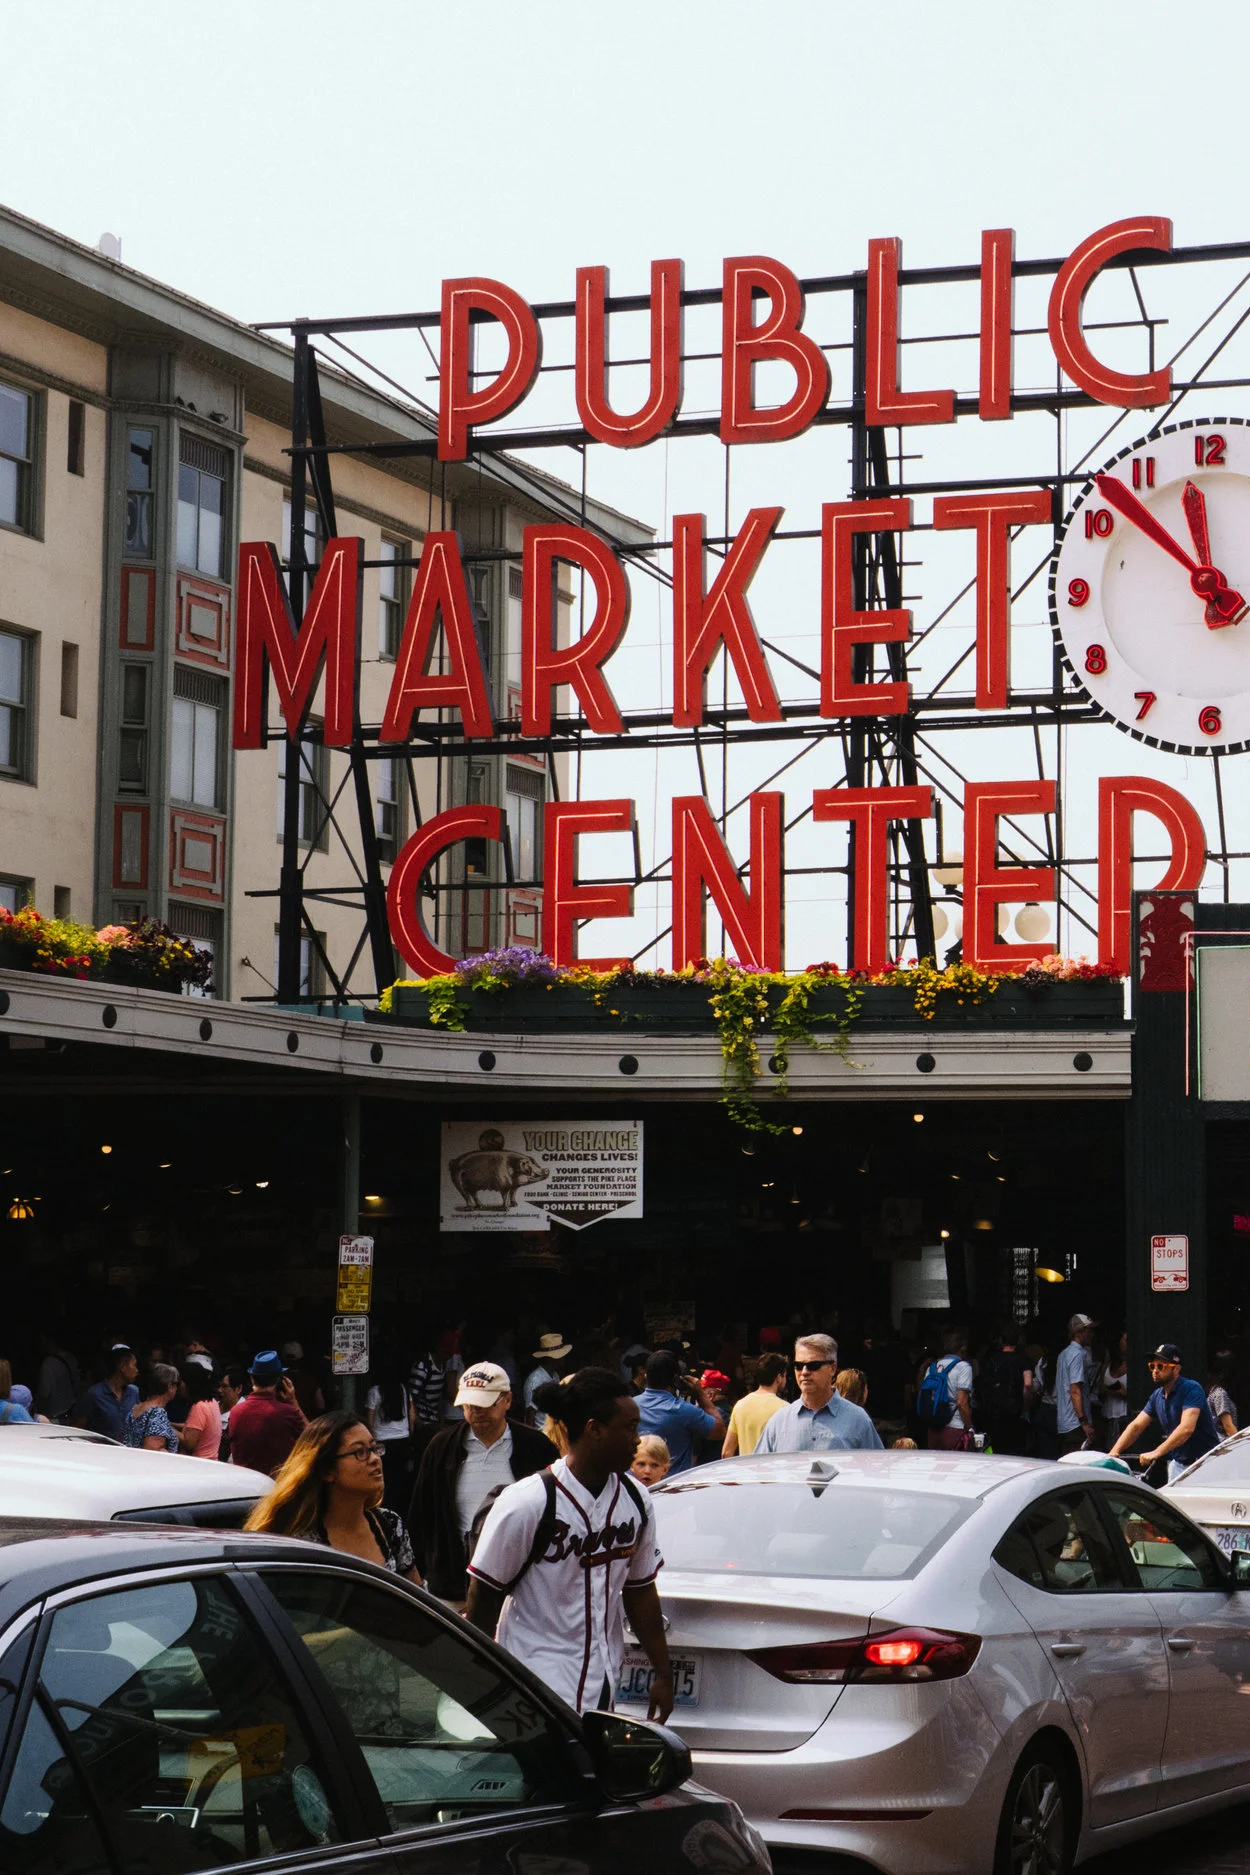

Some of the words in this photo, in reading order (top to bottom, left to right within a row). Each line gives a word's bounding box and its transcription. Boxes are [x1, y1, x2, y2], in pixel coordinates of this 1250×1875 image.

[437, 215, 1173, 462] PUBLIC
[1194, 434, 1226, 466] 12
[1132, 456, 1155, 488] 11
[1085, 509, 1113, 538] 10
[1068, 578, 1090, 607] 9
[233, 489, 1052, 750] MARKET
[1085, 644, 1107, 674] 8
[1134, 691, 1157, 720] 7
[1198, 706, 1222, 735] 6
[523, 1130, 571, 1151] YOUR
[570, 1130, 639, 1151] CHANGE
[541, 1153, 598, 1162] CHANGES
[600, 1153, 638, 1161] LIVES!
[551, 1175, 586, 1183] SUPPORTS
[587, 1175, 600, 1183] THE
[543, 1202, 585, 1211] DONATE
[587, 1202, 618, 1211] HERE!
[344, 1246, 369, 1254] PARKING
[1153, 1238, 1164, 1246] NO
[1156, 1249, 1184, 1258] STOPS
[1217, 1533, 1238, 1550] 286
